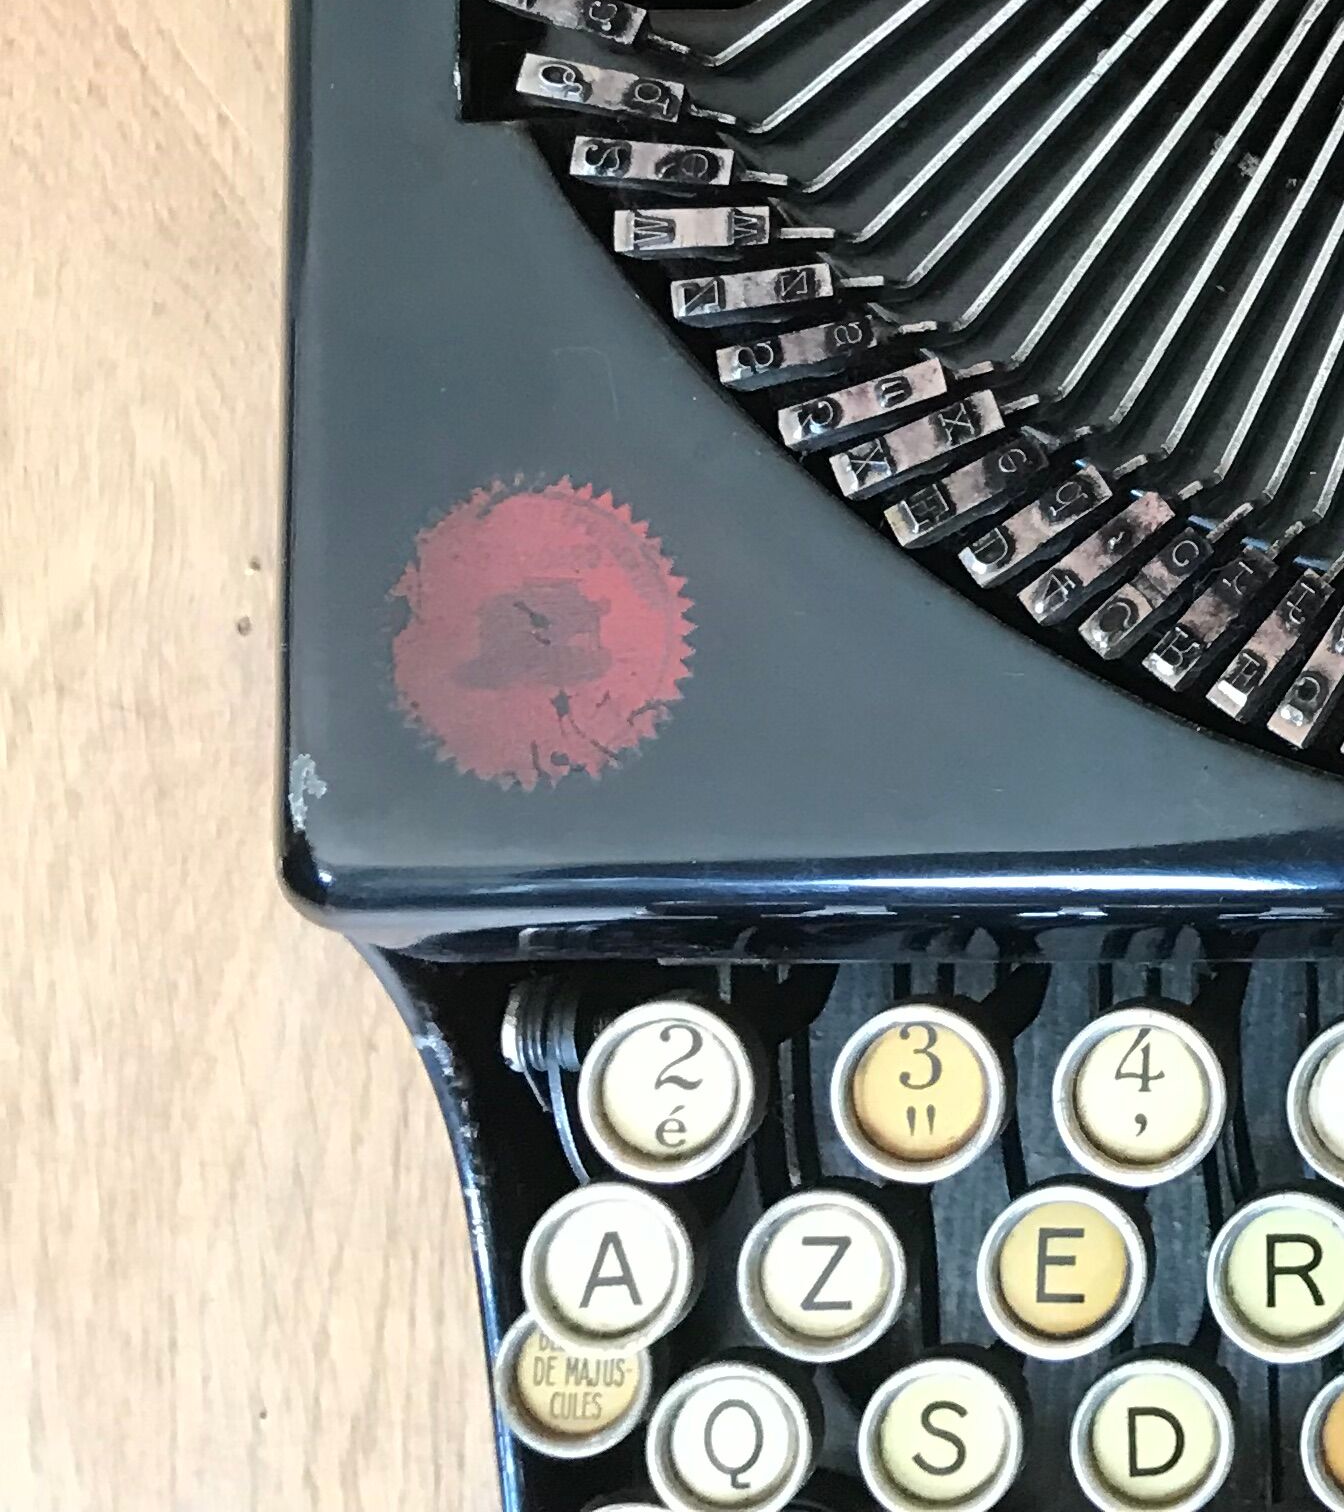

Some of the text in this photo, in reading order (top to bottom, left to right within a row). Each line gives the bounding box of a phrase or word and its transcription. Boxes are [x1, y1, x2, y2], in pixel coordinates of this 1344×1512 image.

[655, 1025, 704, 1091] 2
[897, 1022, 943, 1090] 3
[1115, 1027, 1165, 1093] 4
[655, 1106, 687, 1148] é
[579, 1231, 642, 1308] A
[801, 1235, 853, 1311] Z
[1035, 1227, 1085, 1304] E
[1265, 1233, 1326, 1308] R
[533, 1356, 559, 1386] DE
[550, 1391, 603, 1420] CULES
[704, 1398, 764, 1489] Q
[911, 1401, 968, 1477] S
[1127, 1407, 1186, 1478] D
